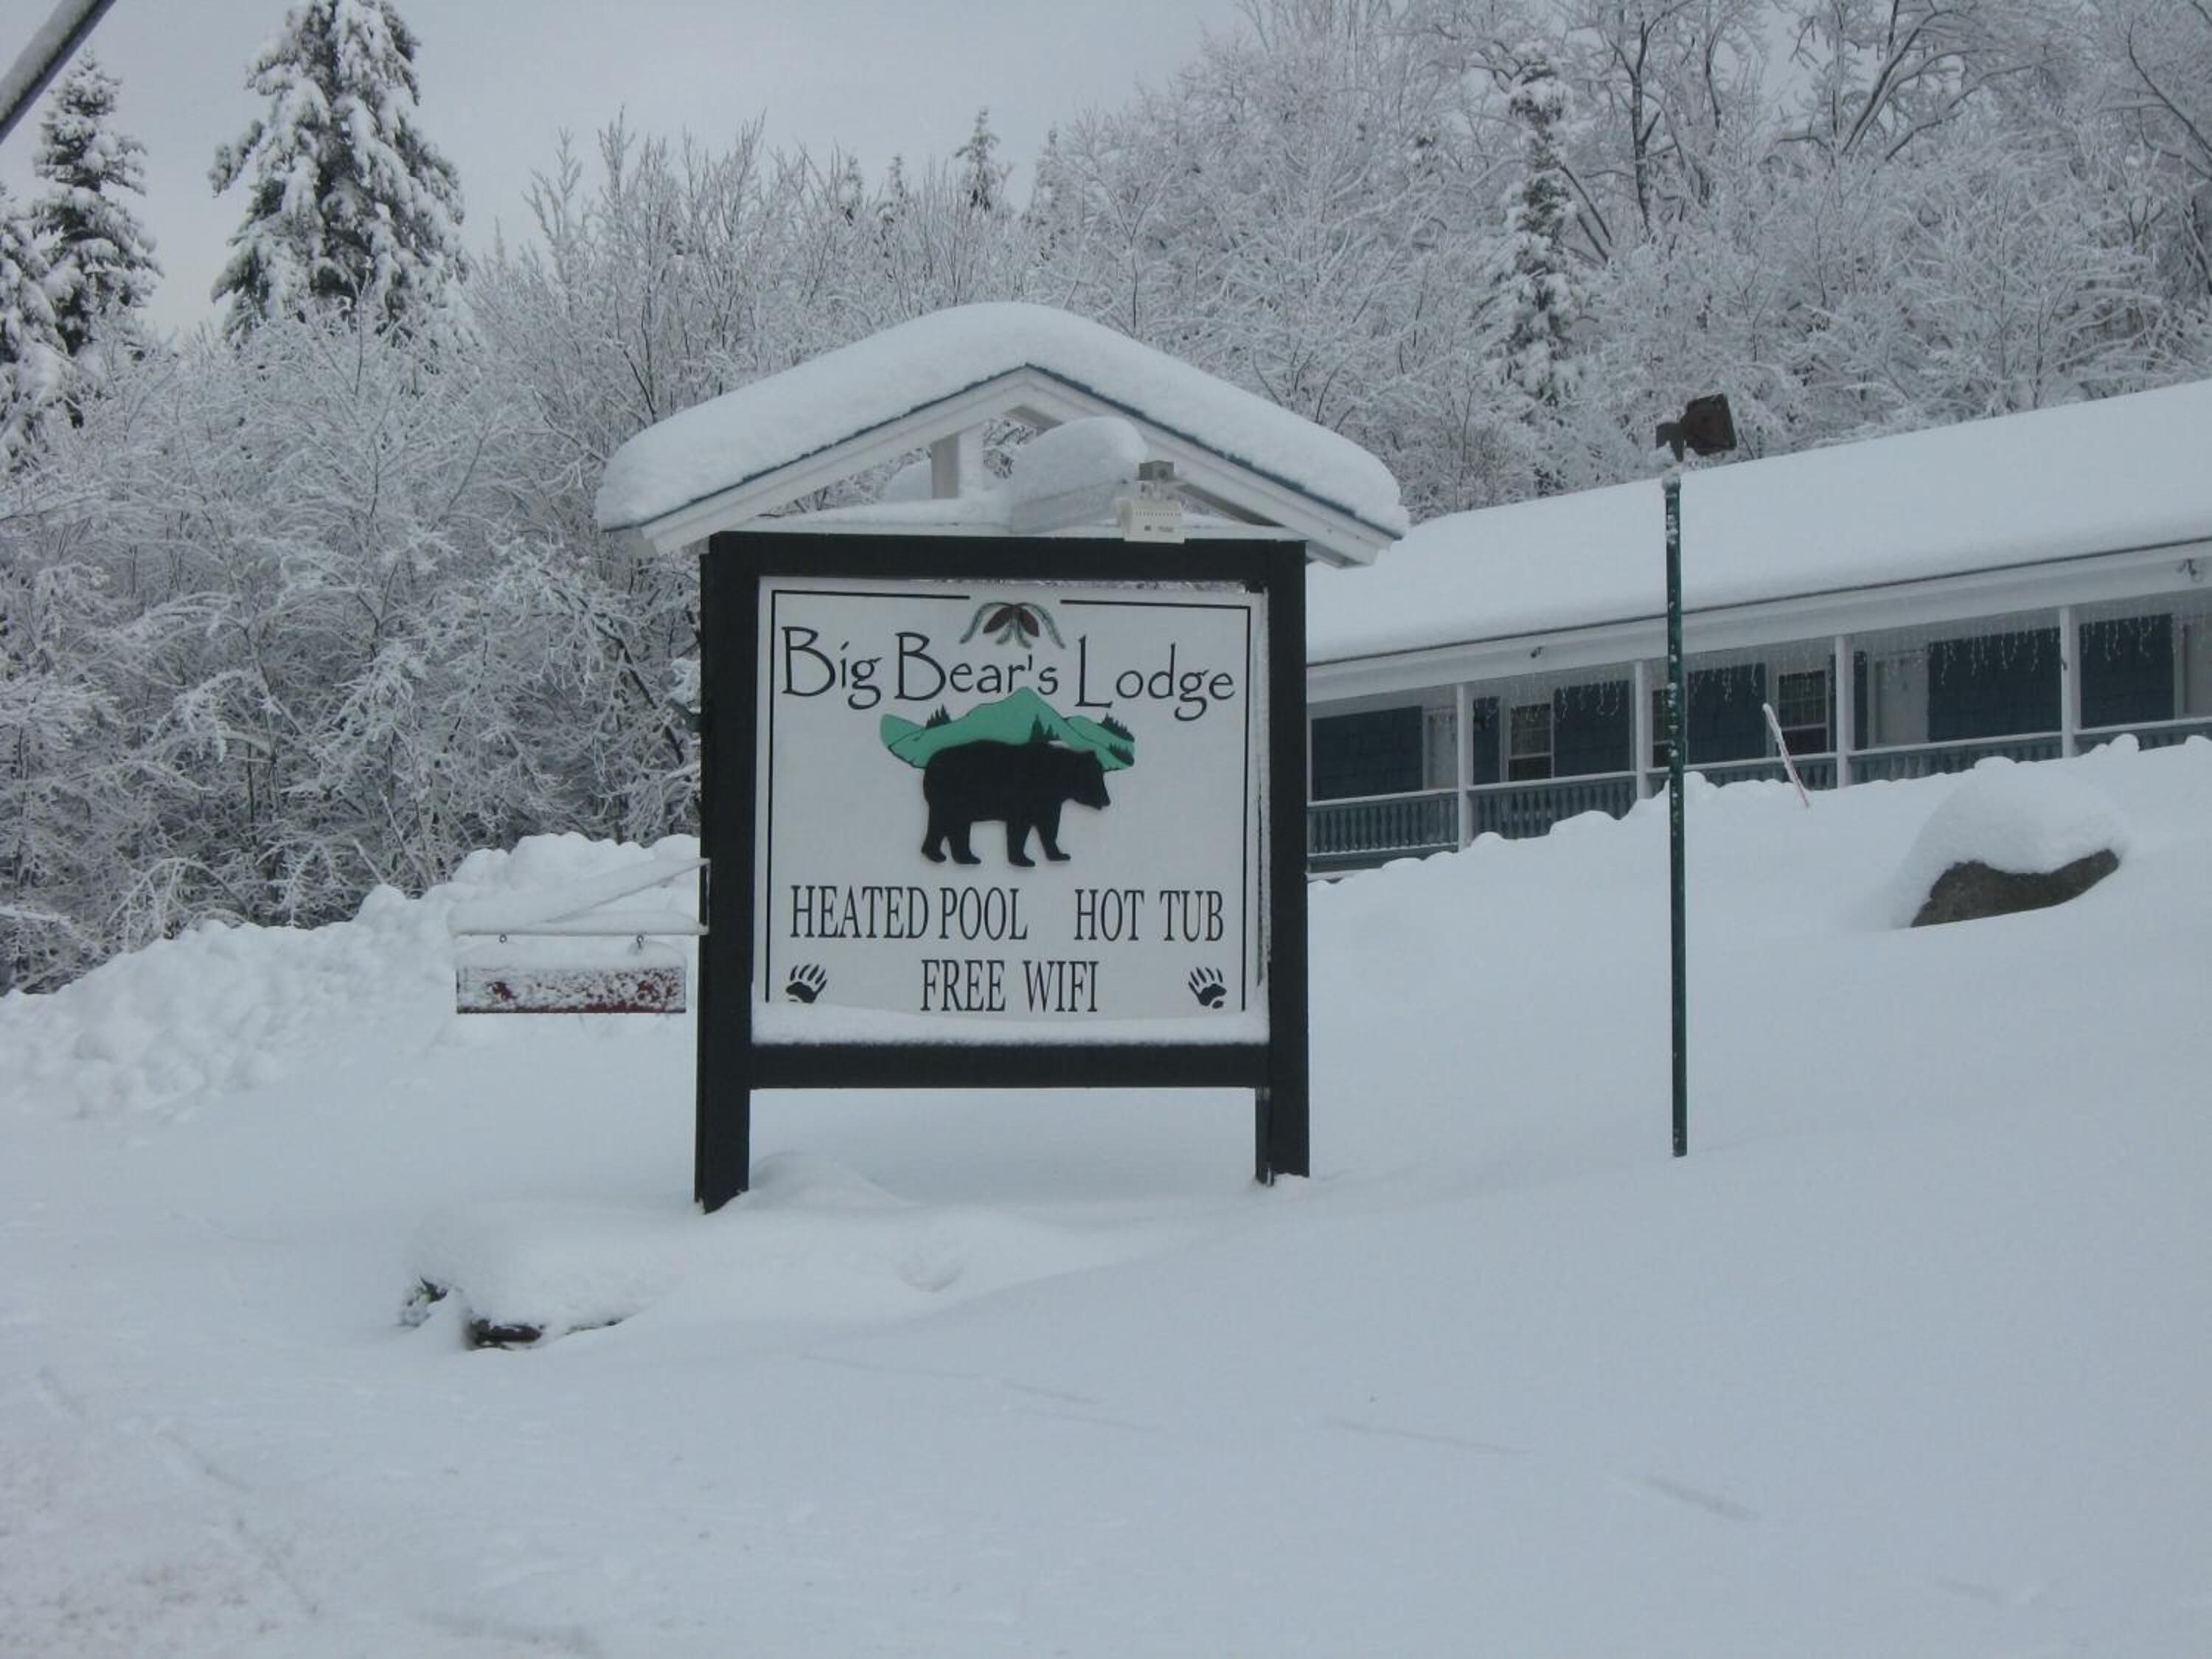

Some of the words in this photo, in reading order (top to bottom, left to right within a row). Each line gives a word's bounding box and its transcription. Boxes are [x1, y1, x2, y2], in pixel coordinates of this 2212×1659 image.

[782, 626, 882, 710] Big
[894, 631, 1060, 701] Bear's
[1074, 635, 1237, 722] Lodge
[790, 884, 929, 939] HEATED
[939, 886, 1028, 942] POOL
[1074, 888, 1145, 942] HOT
[1159, 889, 1224, 943] TUB
[919, 959, 1006, 1012] FREE
[1022, 959, 1099, 1012] WIFI
